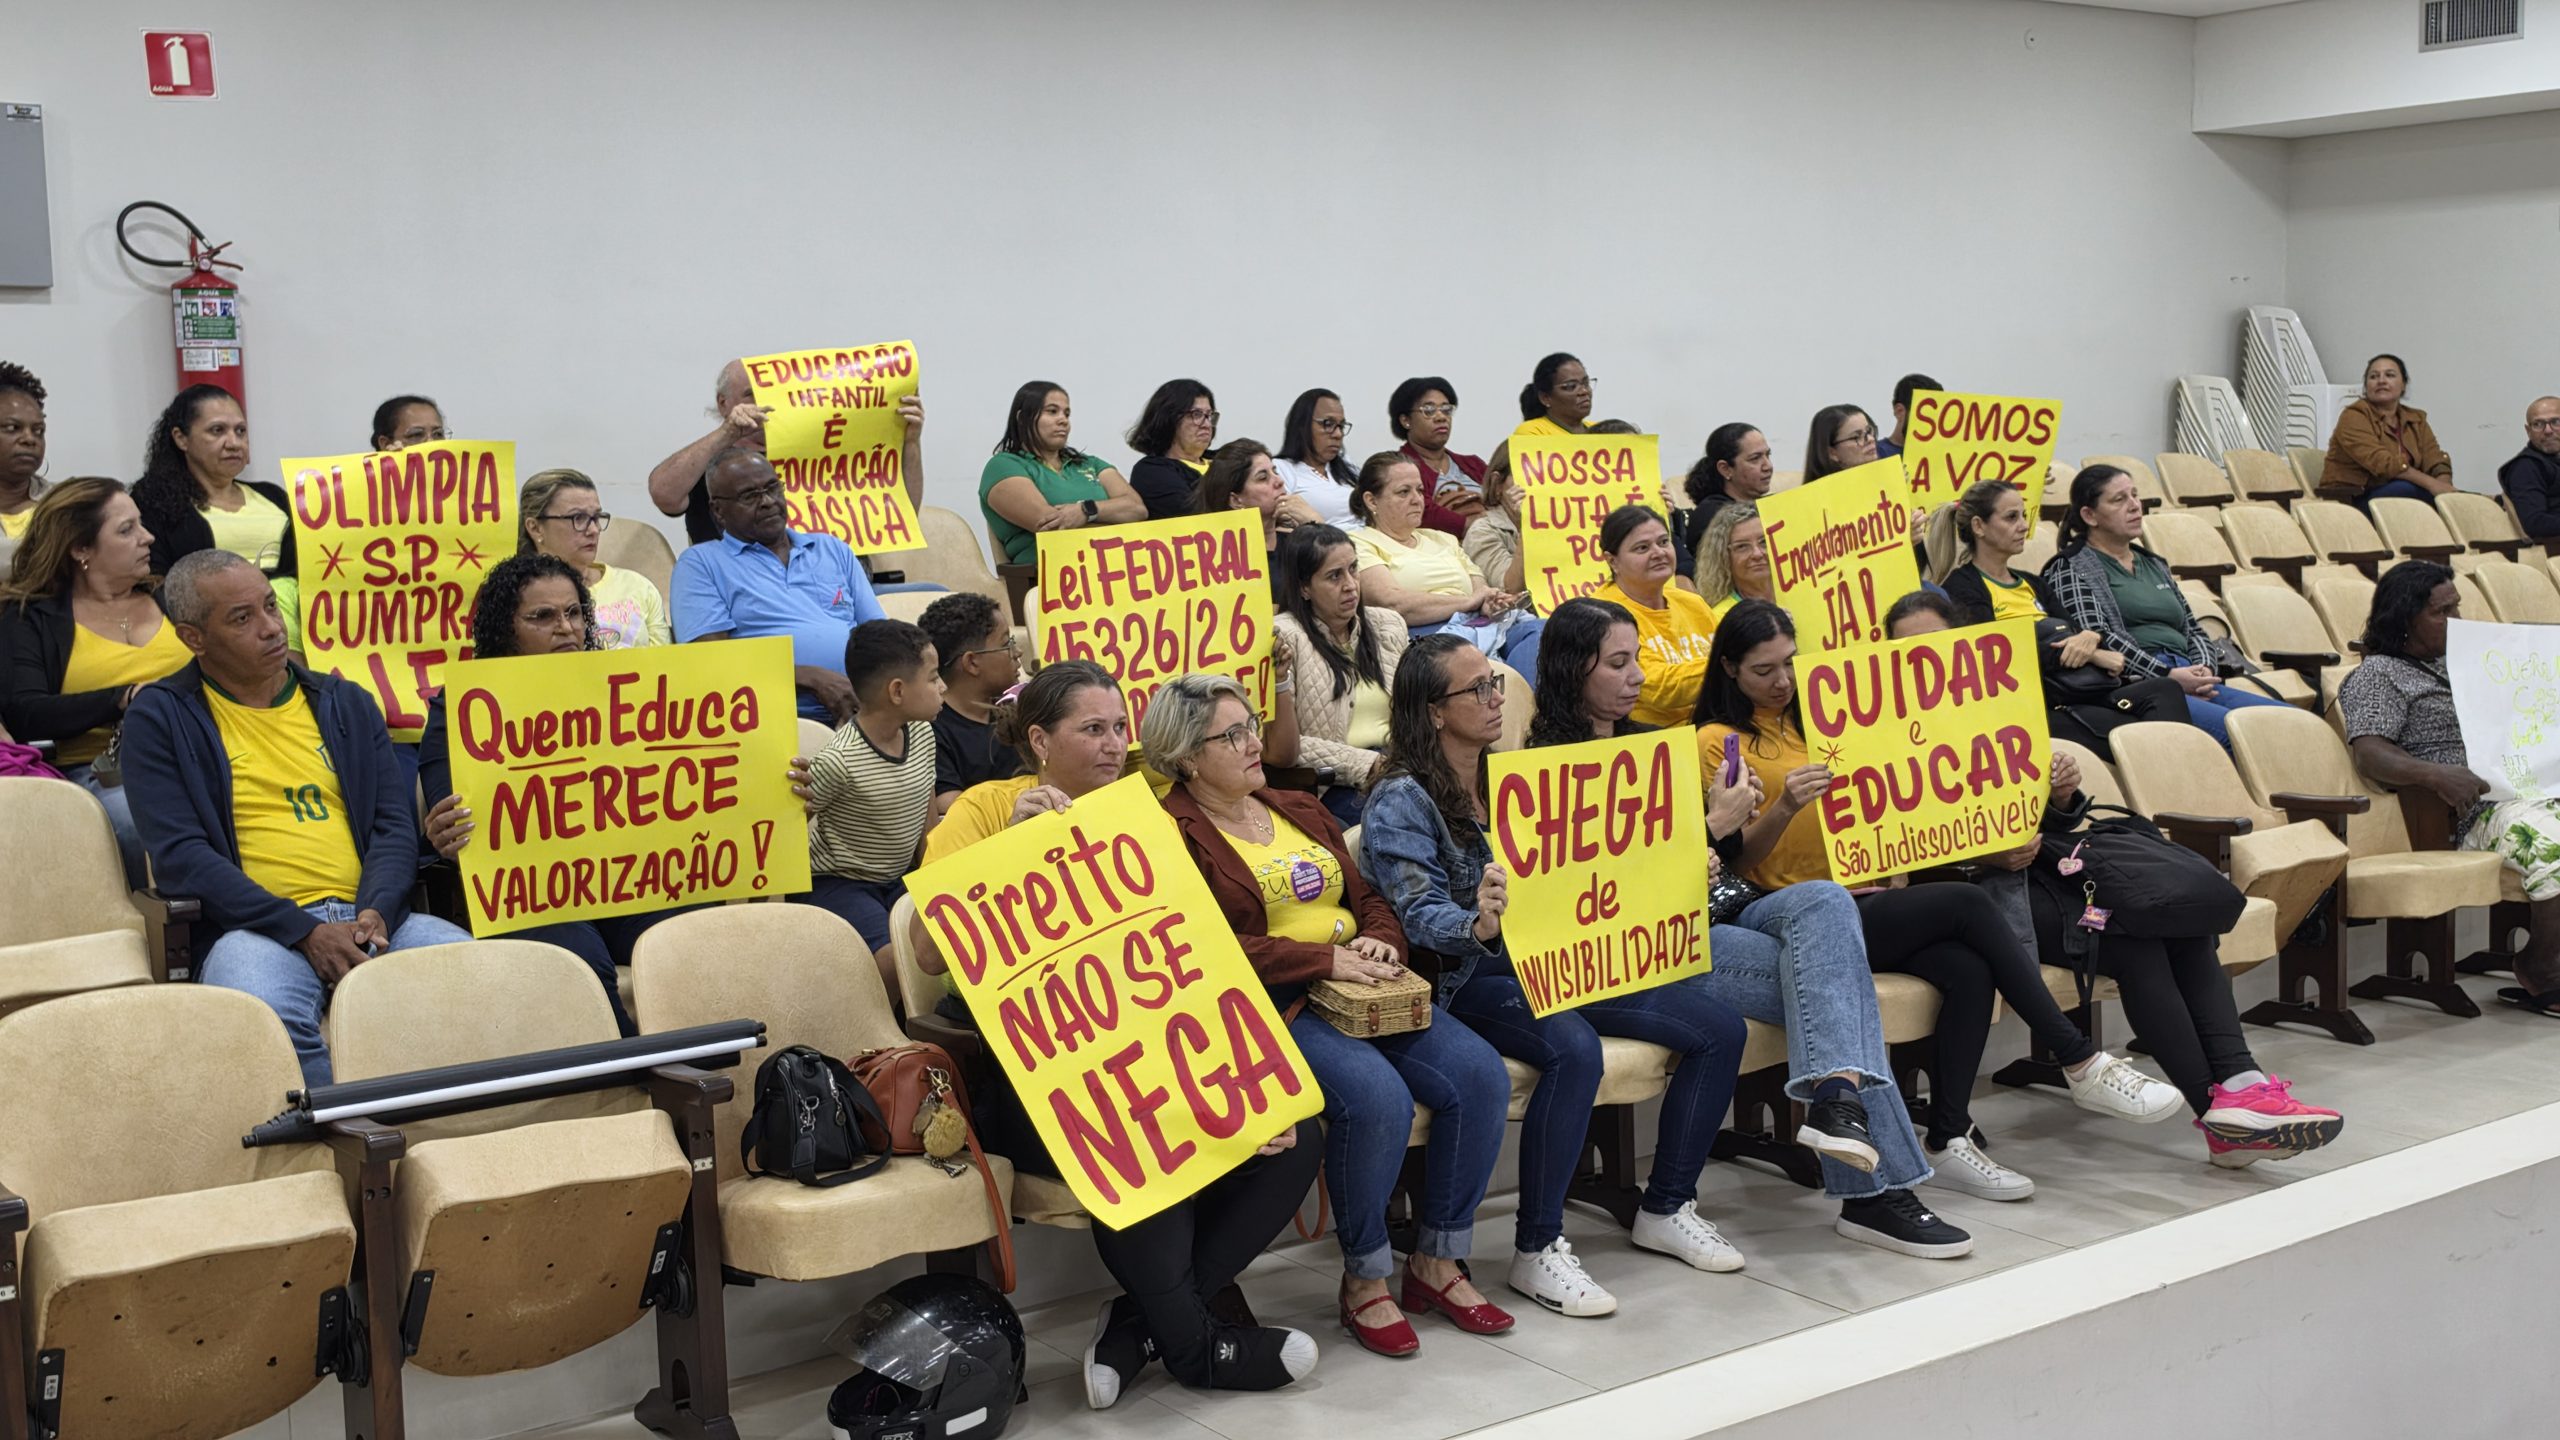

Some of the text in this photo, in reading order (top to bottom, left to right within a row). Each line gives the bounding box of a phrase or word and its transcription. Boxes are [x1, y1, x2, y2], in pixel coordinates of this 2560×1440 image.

[748, 345, 912, 387] EDUCAÇÃO
[788, 386, 888, 408] INFANTIL
[823, 413, 847, 449] É
[1912, 398, 2055, 445] SOMOS
[295, 449, 501, 530] OLÍMPIA
[1521, 448, 1636, 486] NOSSA
[1911, 451, 2037, 493] A VOZ
[786, 493, 912, 547] BÁSICA
[1529, 494, 1611, 530] LUTA
[1567, 534, 1606, 566] PO
[1766, 490, 1907, 592] Enquadramento
[1041, 528, 1262, 613] Lei FEDERAL
[458, 672, 760, 766] Quem Educa
[1807, 633, 2019, 738] CUIDAR
[1909, 720, 1927, 746] e
[283, 783, 330, 823] 10
[489, 754, 739, 851] MERECE
[1496, 741, 1673, 878] CHEGA
[1820, 724, 2041, 835] EDUCAR
[1834, 790, 2039, 878] São Indissociáveis
[925, 825, 1155, 986] Direito
[1575, 871, 1621, 926] de
[999, 912, 1204, 1072] NÃO SE
[1517, 909, 1701, 1014] INVISIBILIDADE
[1047, 986, 1302, 1205] NEGA
